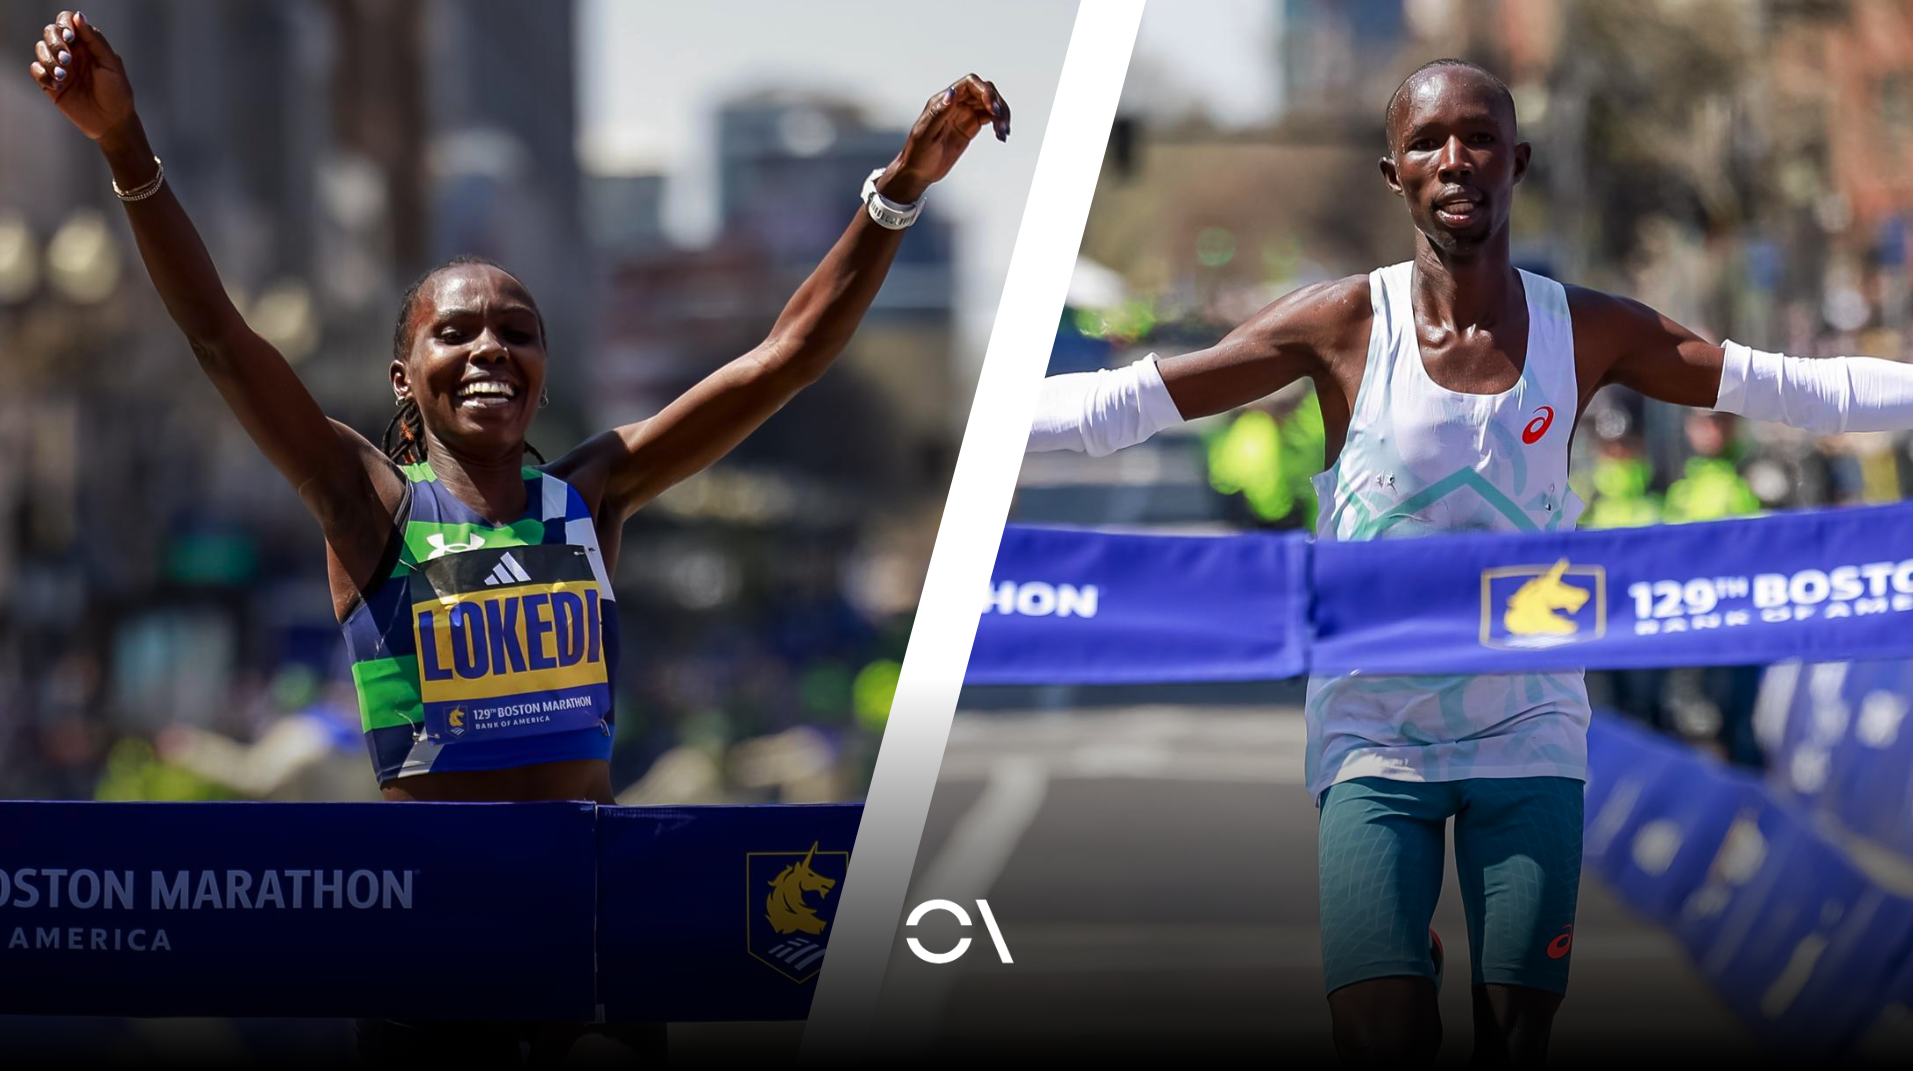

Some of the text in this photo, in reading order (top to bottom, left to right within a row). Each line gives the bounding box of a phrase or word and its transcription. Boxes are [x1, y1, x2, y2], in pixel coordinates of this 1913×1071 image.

[1628, 576, 1749, 619] 129TH
[418, 589, 601, 682] LOKEDI
[473, 696, 592, 720] 129TH BOSTON MARATHON
[476, 715, 551, 730] BANK OF AMERICA
[150, 868, 414, 910] MARATHON
[8, 927, 172, 951] AMERICA
